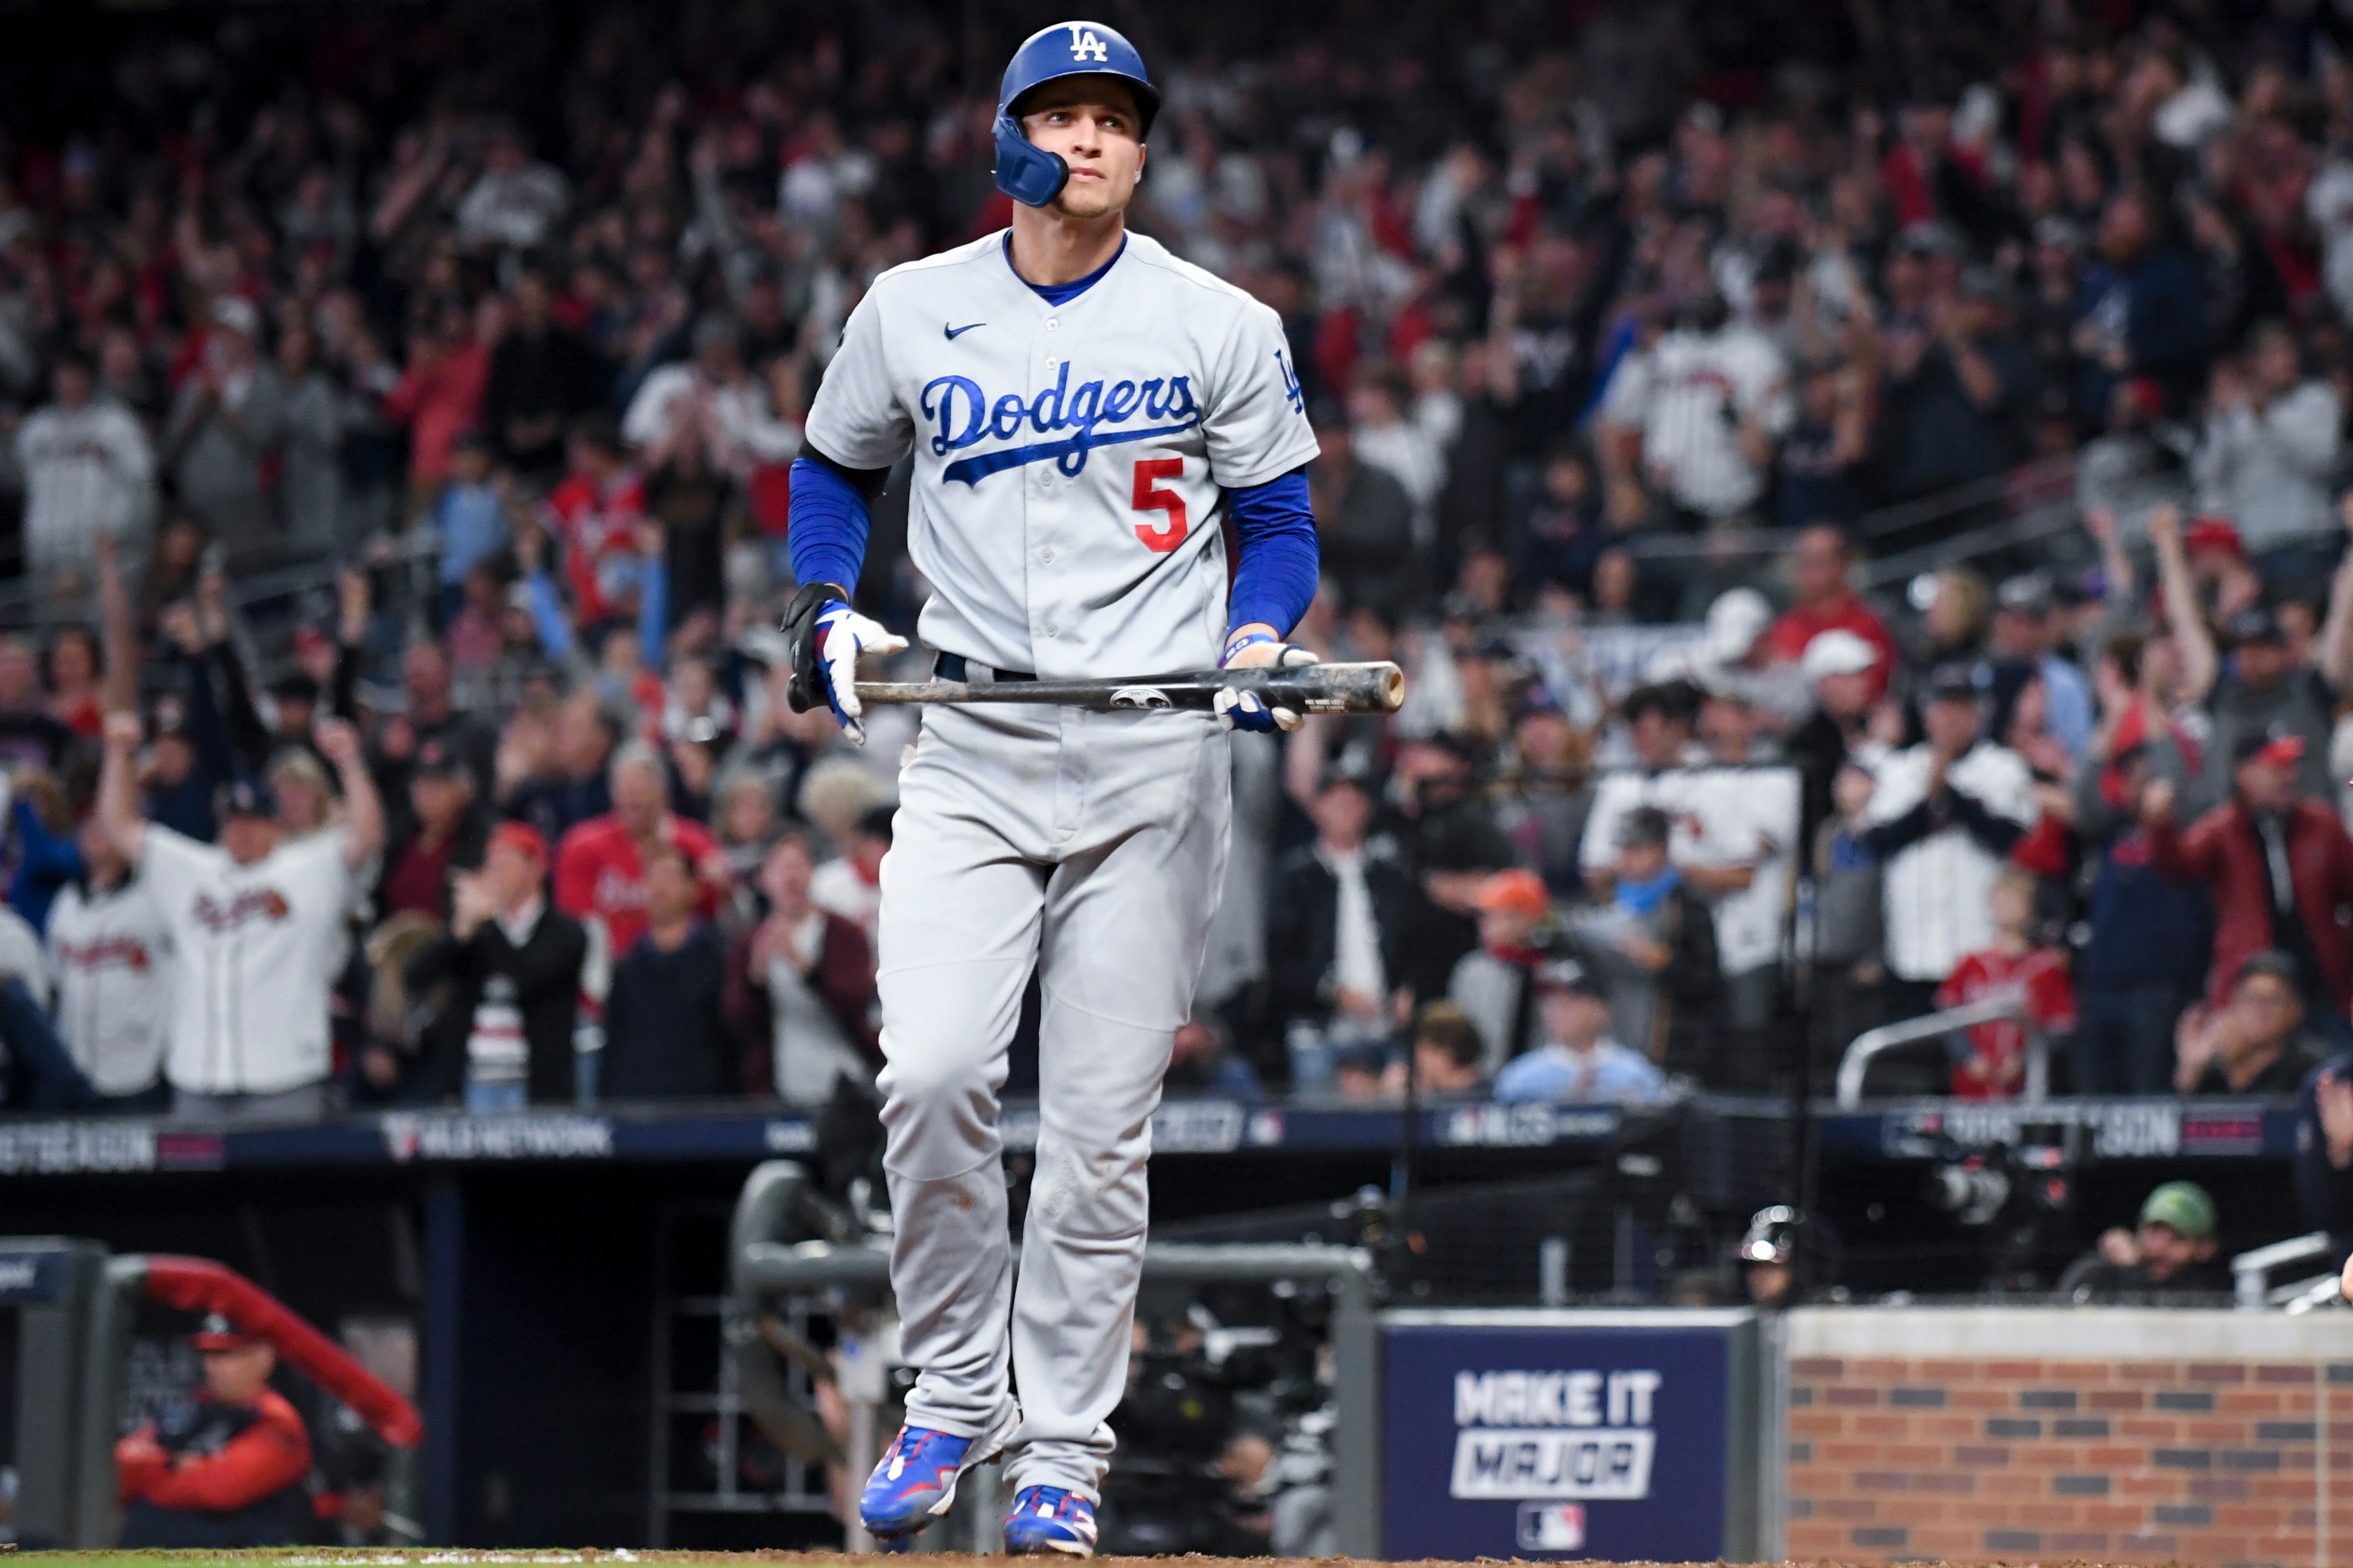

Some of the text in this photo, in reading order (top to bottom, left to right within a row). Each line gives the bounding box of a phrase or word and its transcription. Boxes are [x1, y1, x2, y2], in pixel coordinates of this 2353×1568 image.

[1068, 25, 1108, 62] LA
[920, 361, 1200, 477] Dodgers
[1131, 457, 1188, 552] 5
[1454, 1369, 1663, 1426] MAKE IT
[1463, 1439, 1636, 1488] MAJOR
